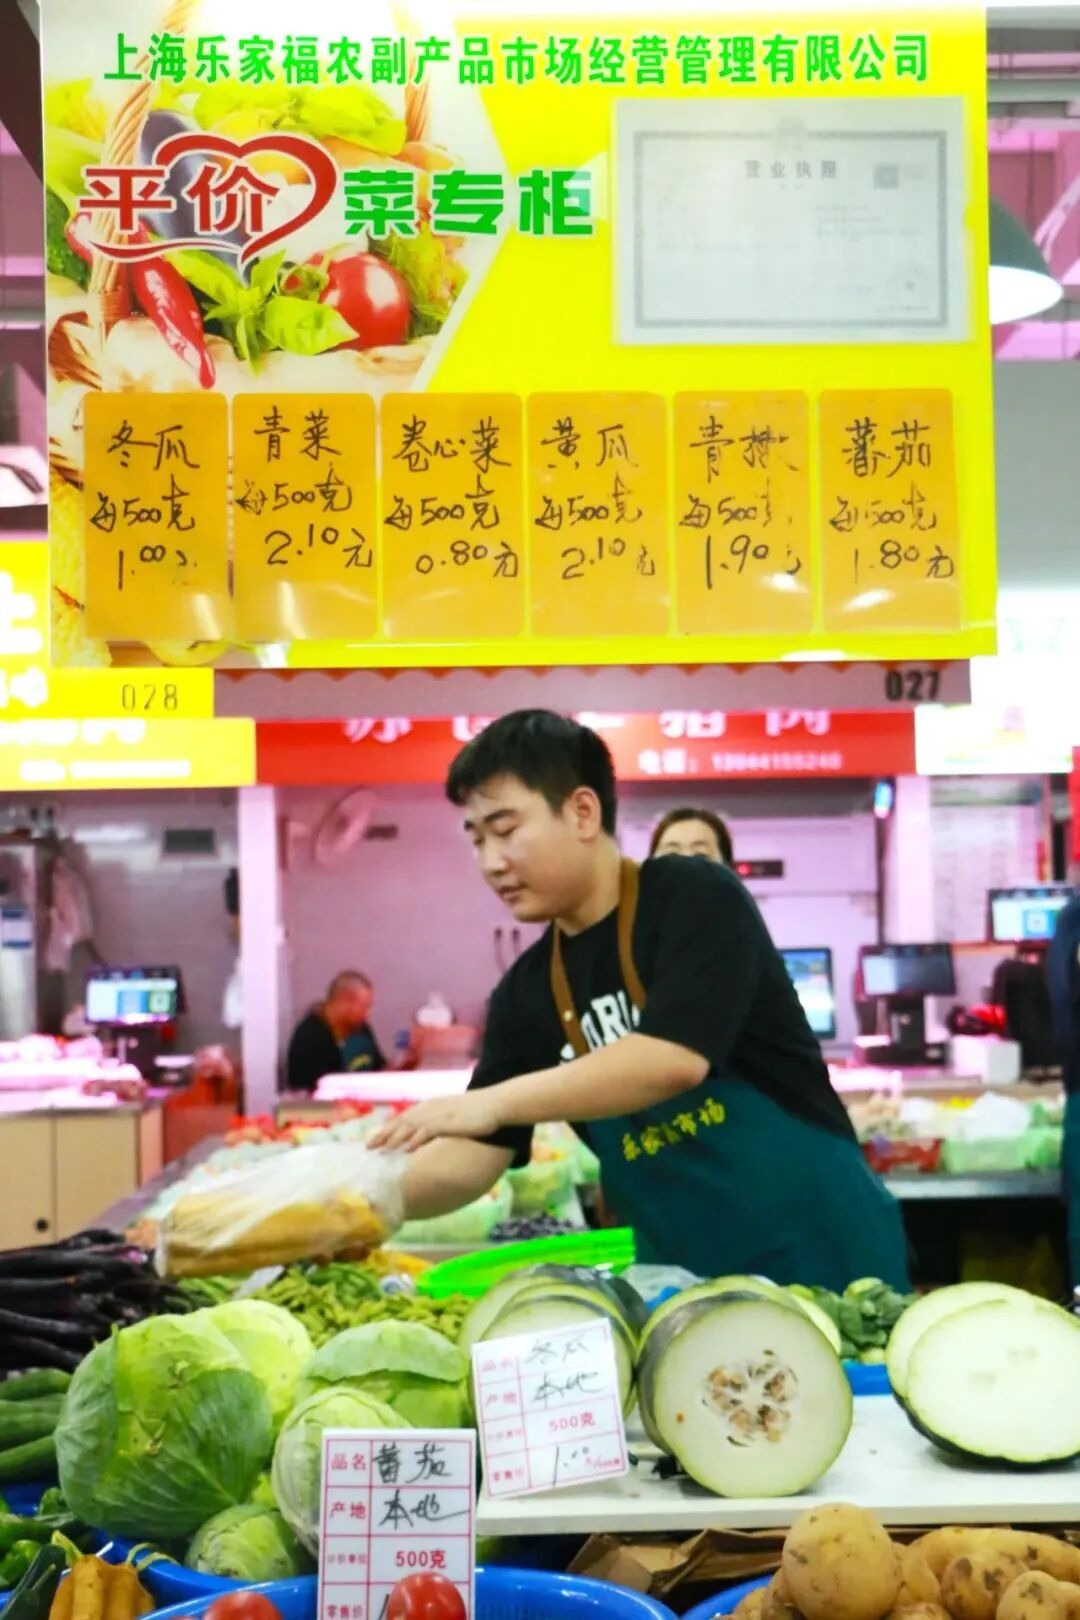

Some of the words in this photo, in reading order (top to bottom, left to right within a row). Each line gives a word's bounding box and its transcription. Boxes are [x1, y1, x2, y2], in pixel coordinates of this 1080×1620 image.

[103, 32, 929, 86] 上海乐家福农副产品市场经营管理有限公司
[80, 165, 280, 234] 平价
[343, 168, 595, 238] 菜专柜
[107, 419, 201, 471] 冬瓜
[254, 405, 342, 462] 青菜
[392, 414, 512, 474] 卷心菜
[540, 416, 640, 470] 黄瓜
[90, 473, 196, 532] 每500克
[235, 463, 353, 516] 每500克
[384, 474, 500, 531] 每500克
[535, 473, 643, 531] 每500克
[264, 523, 373, 569] 2.10元
[416, 540, 519, 578] 0.80元
[854, 539, 955, 585] 1.80元
[121, 684, 179, 712] 028
[884, 669, 941, 702] 027
[548, 1412, 596, 1432] 500克
[331, 1452, 366, 1471] 品名
[330, 1501, 366, 1520] 产地
[379, 1489, 471, 1530] 本地
[395, 1550, 447, 1569] 500克
